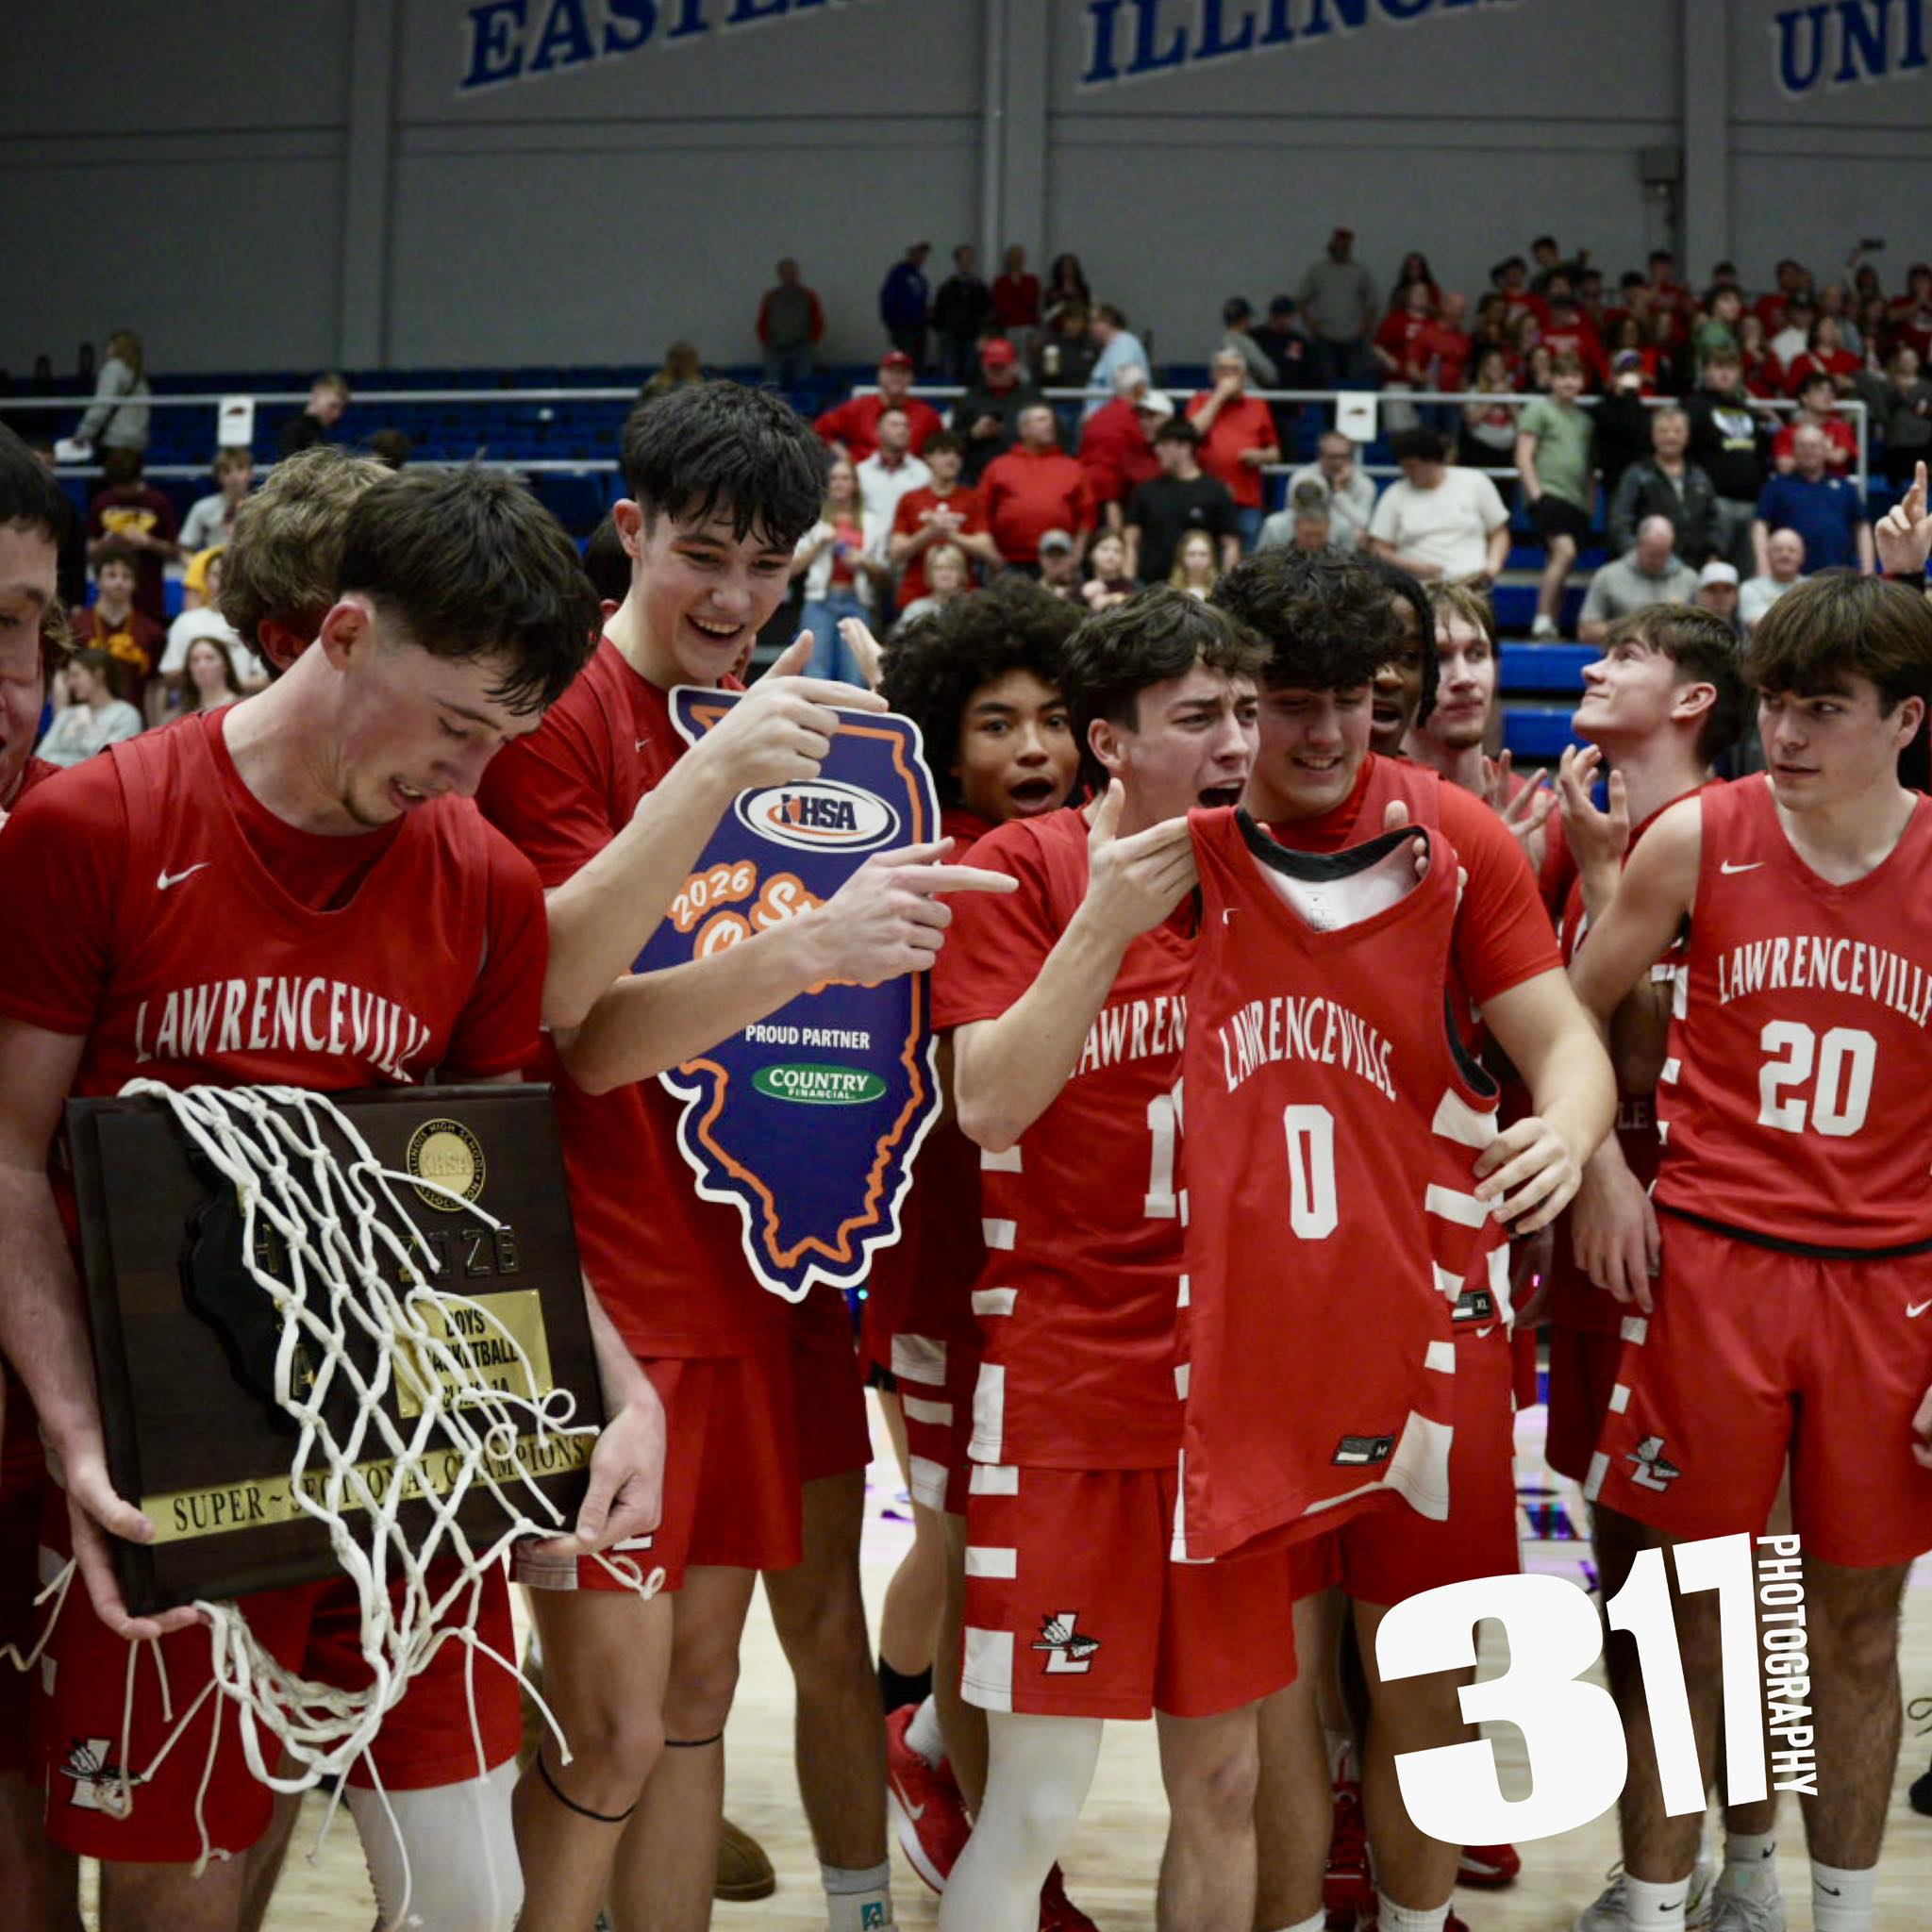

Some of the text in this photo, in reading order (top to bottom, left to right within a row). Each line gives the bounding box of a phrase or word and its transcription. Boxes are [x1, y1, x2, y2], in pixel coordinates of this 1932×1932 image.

[781, 793, 857, 831] IHSA
[671, 866, 751, 926] 2026
[744, 1024, 871, 1050] PROUD PARTNER
[1068, 995, 1188, 1080] AWREN
[1218, 995, 1398, 1103] LAWRENCEVILLE
[1757, 1019, 1877, 1137] 20
[769, 1068, 870, 1092] COUNTRY
[1143, 1075, 1190, 1228] 1
[1283, 1104, 1339, 1240] 0
